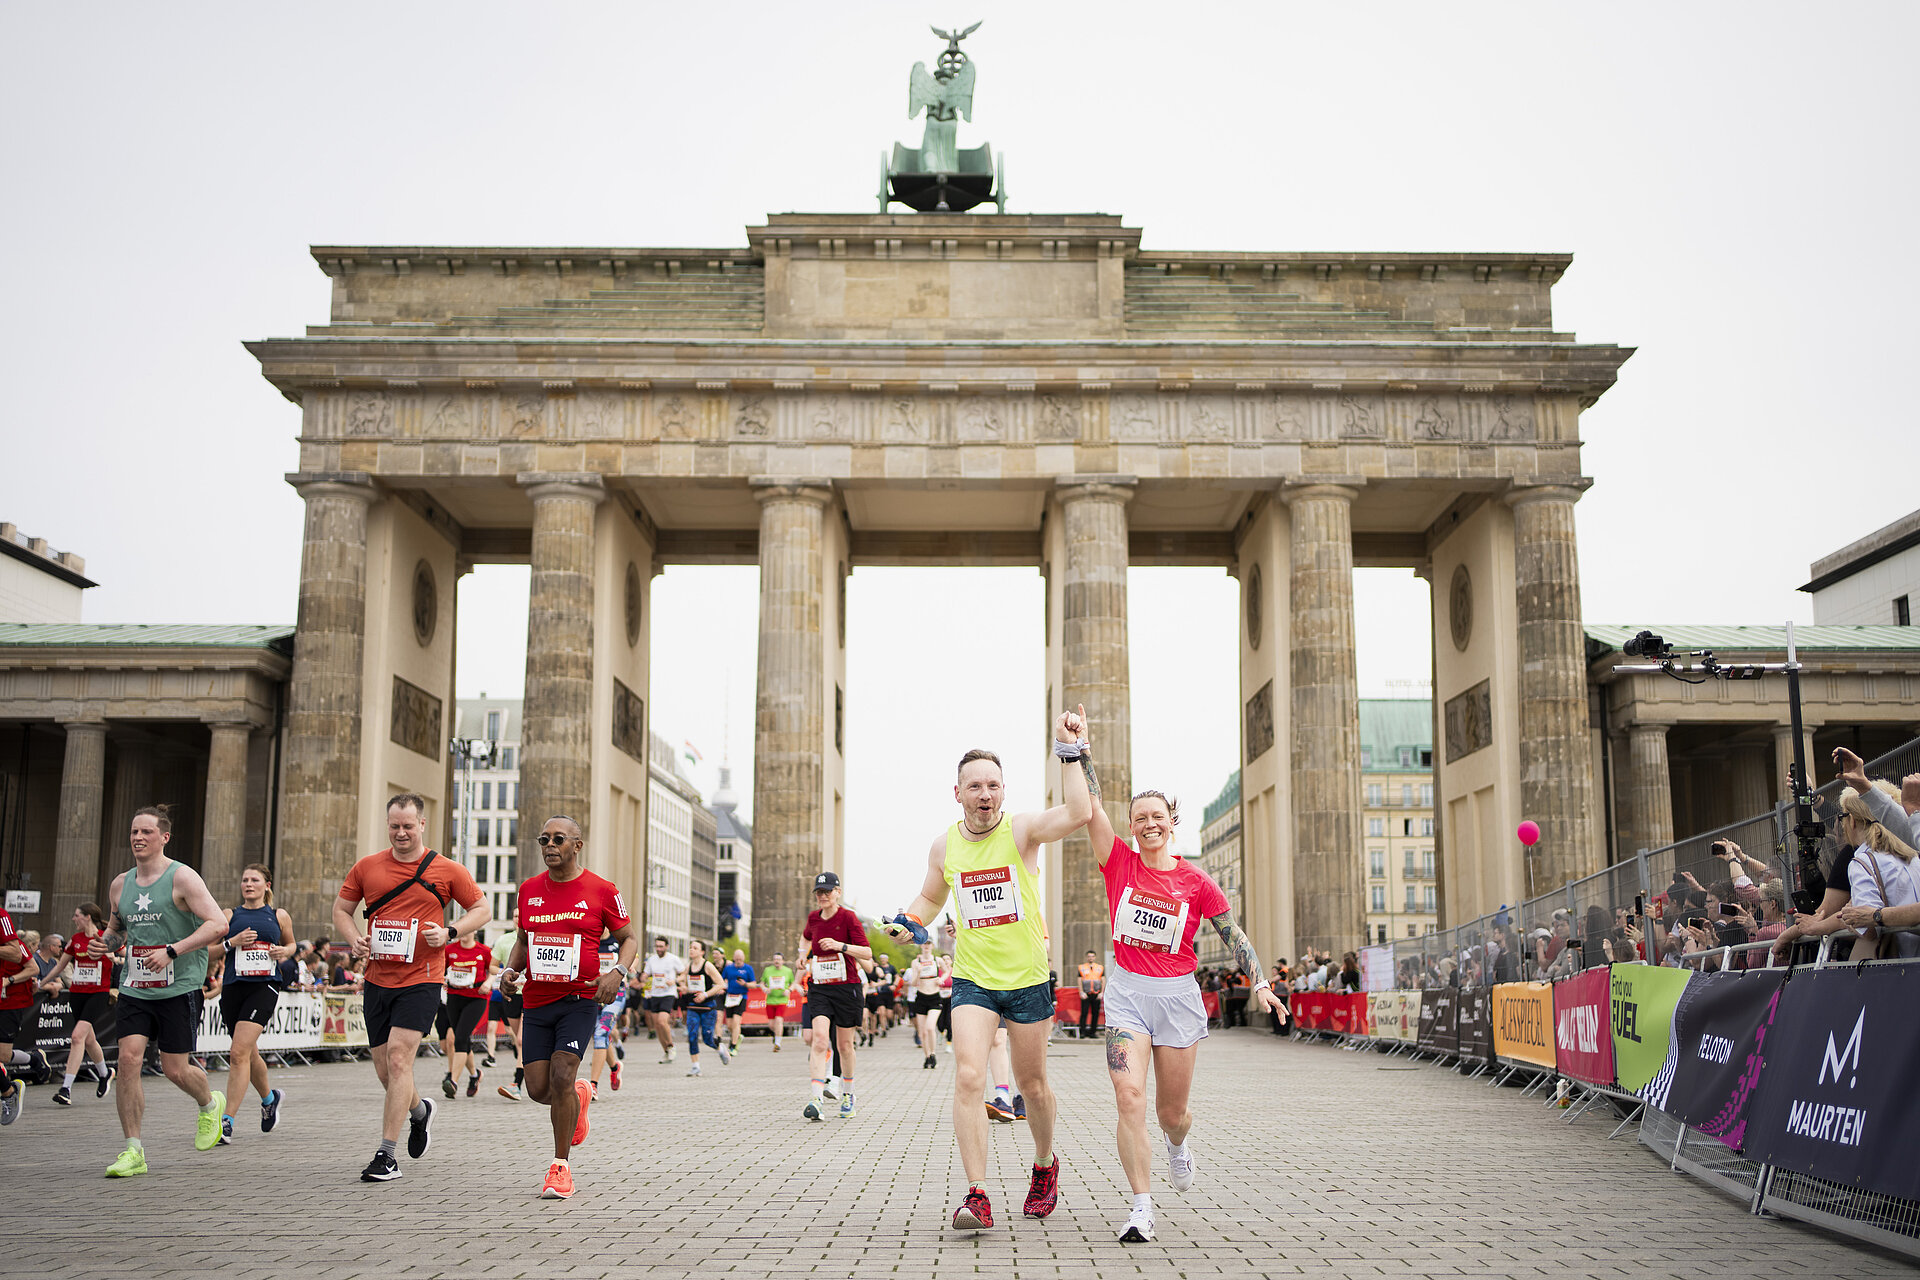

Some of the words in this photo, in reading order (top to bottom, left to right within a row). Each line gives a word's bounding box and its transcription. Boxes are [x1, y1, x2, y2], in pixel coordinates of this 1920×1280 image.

[974, 872, 1005, 882] GENERALI
[972, 886, 1004, 903] 17002
[1142, 897, 1176, 911] GENERALI
[127, 913, 162, 922] SAYSKY
[529, 911, 585, 923] #BERLINHALF
[1133, 909, 1167, 930] 23160
[378, 930, 403, 942] 20578
[542, 936, 570, 944] GENERALI
[537, 948, 565, 961] 56842
[1623, 981, 1633, 1001] your
[38, 1016, 63, 1028] Berlin
[262, 1006, 282, 1034] AS
[285, 1005, 308, 1034] ZIEL!
[1613, 999, 1642, 1044] FUEL
[1786, 1099, 1867, 1146] MAURTEN
